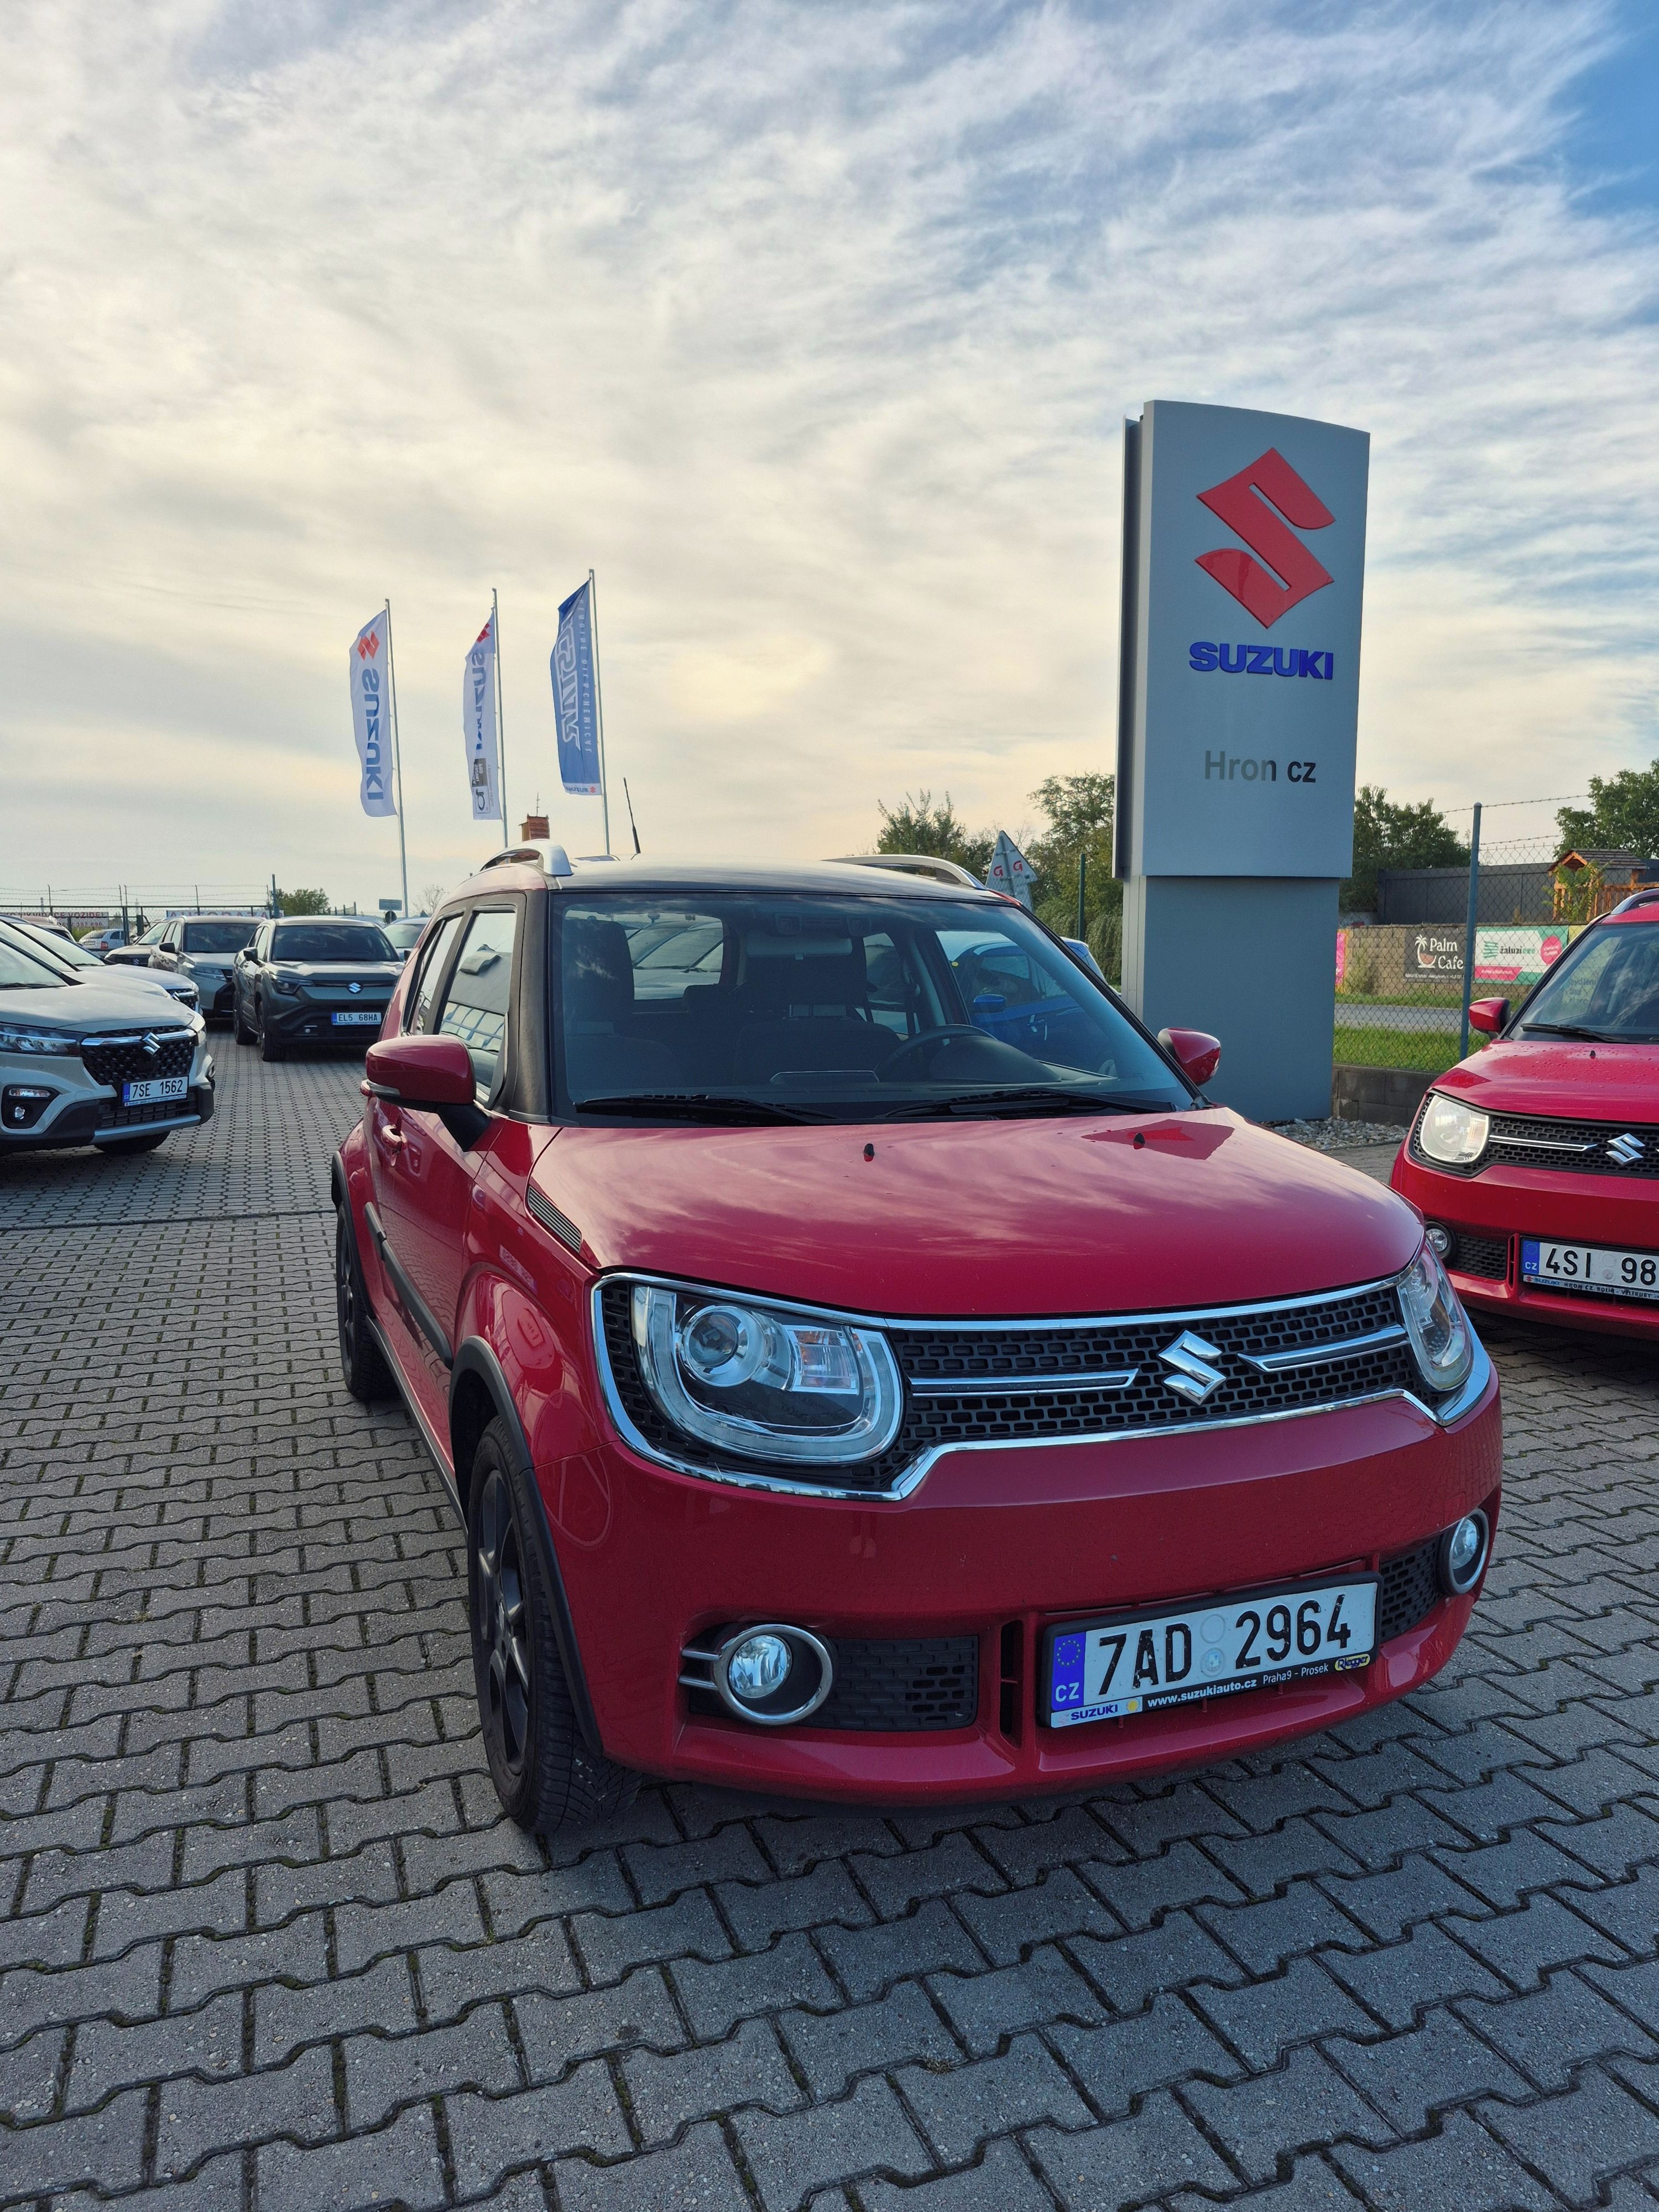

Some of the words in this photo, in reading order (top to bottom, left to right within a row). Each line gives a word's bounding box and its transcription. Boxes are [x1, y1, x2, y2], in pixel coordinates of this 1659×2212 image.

[1190, 641, 1333, 680] SUZUKI
[1204, 750, 1277, 781] Hron
[1287, 761, 1316, 783] cz
[1430, 938, 1458, 951] Palm
[1438, 955, 1464, 969] Cafe
[133, 1083, 152, 1098] 7SE
[160, 1079, 183, 1094] 1562
[1525, 1261, 1537, 1270] CZ
[1546, 1248, 1591, 1278] 4SI
[1564, 1282, 1583, 1291] HRON
[1621, 1289, 1651, 1298] VELTRUBY
[1055, 1682, 1079, 1702] CZ
[1098, 1623, 1192, 1695] 7AD
[1235, 1594, 1352, 1670] 2964
[1071, 1704, 1118, 1720] SUZUKI
[1147, 1679, 1257, 1708] www.suzukiauto.cz
[1262, 1670, 1292, 1685] Praha9
[1301, 1663, 1329, 1677] Prosek
